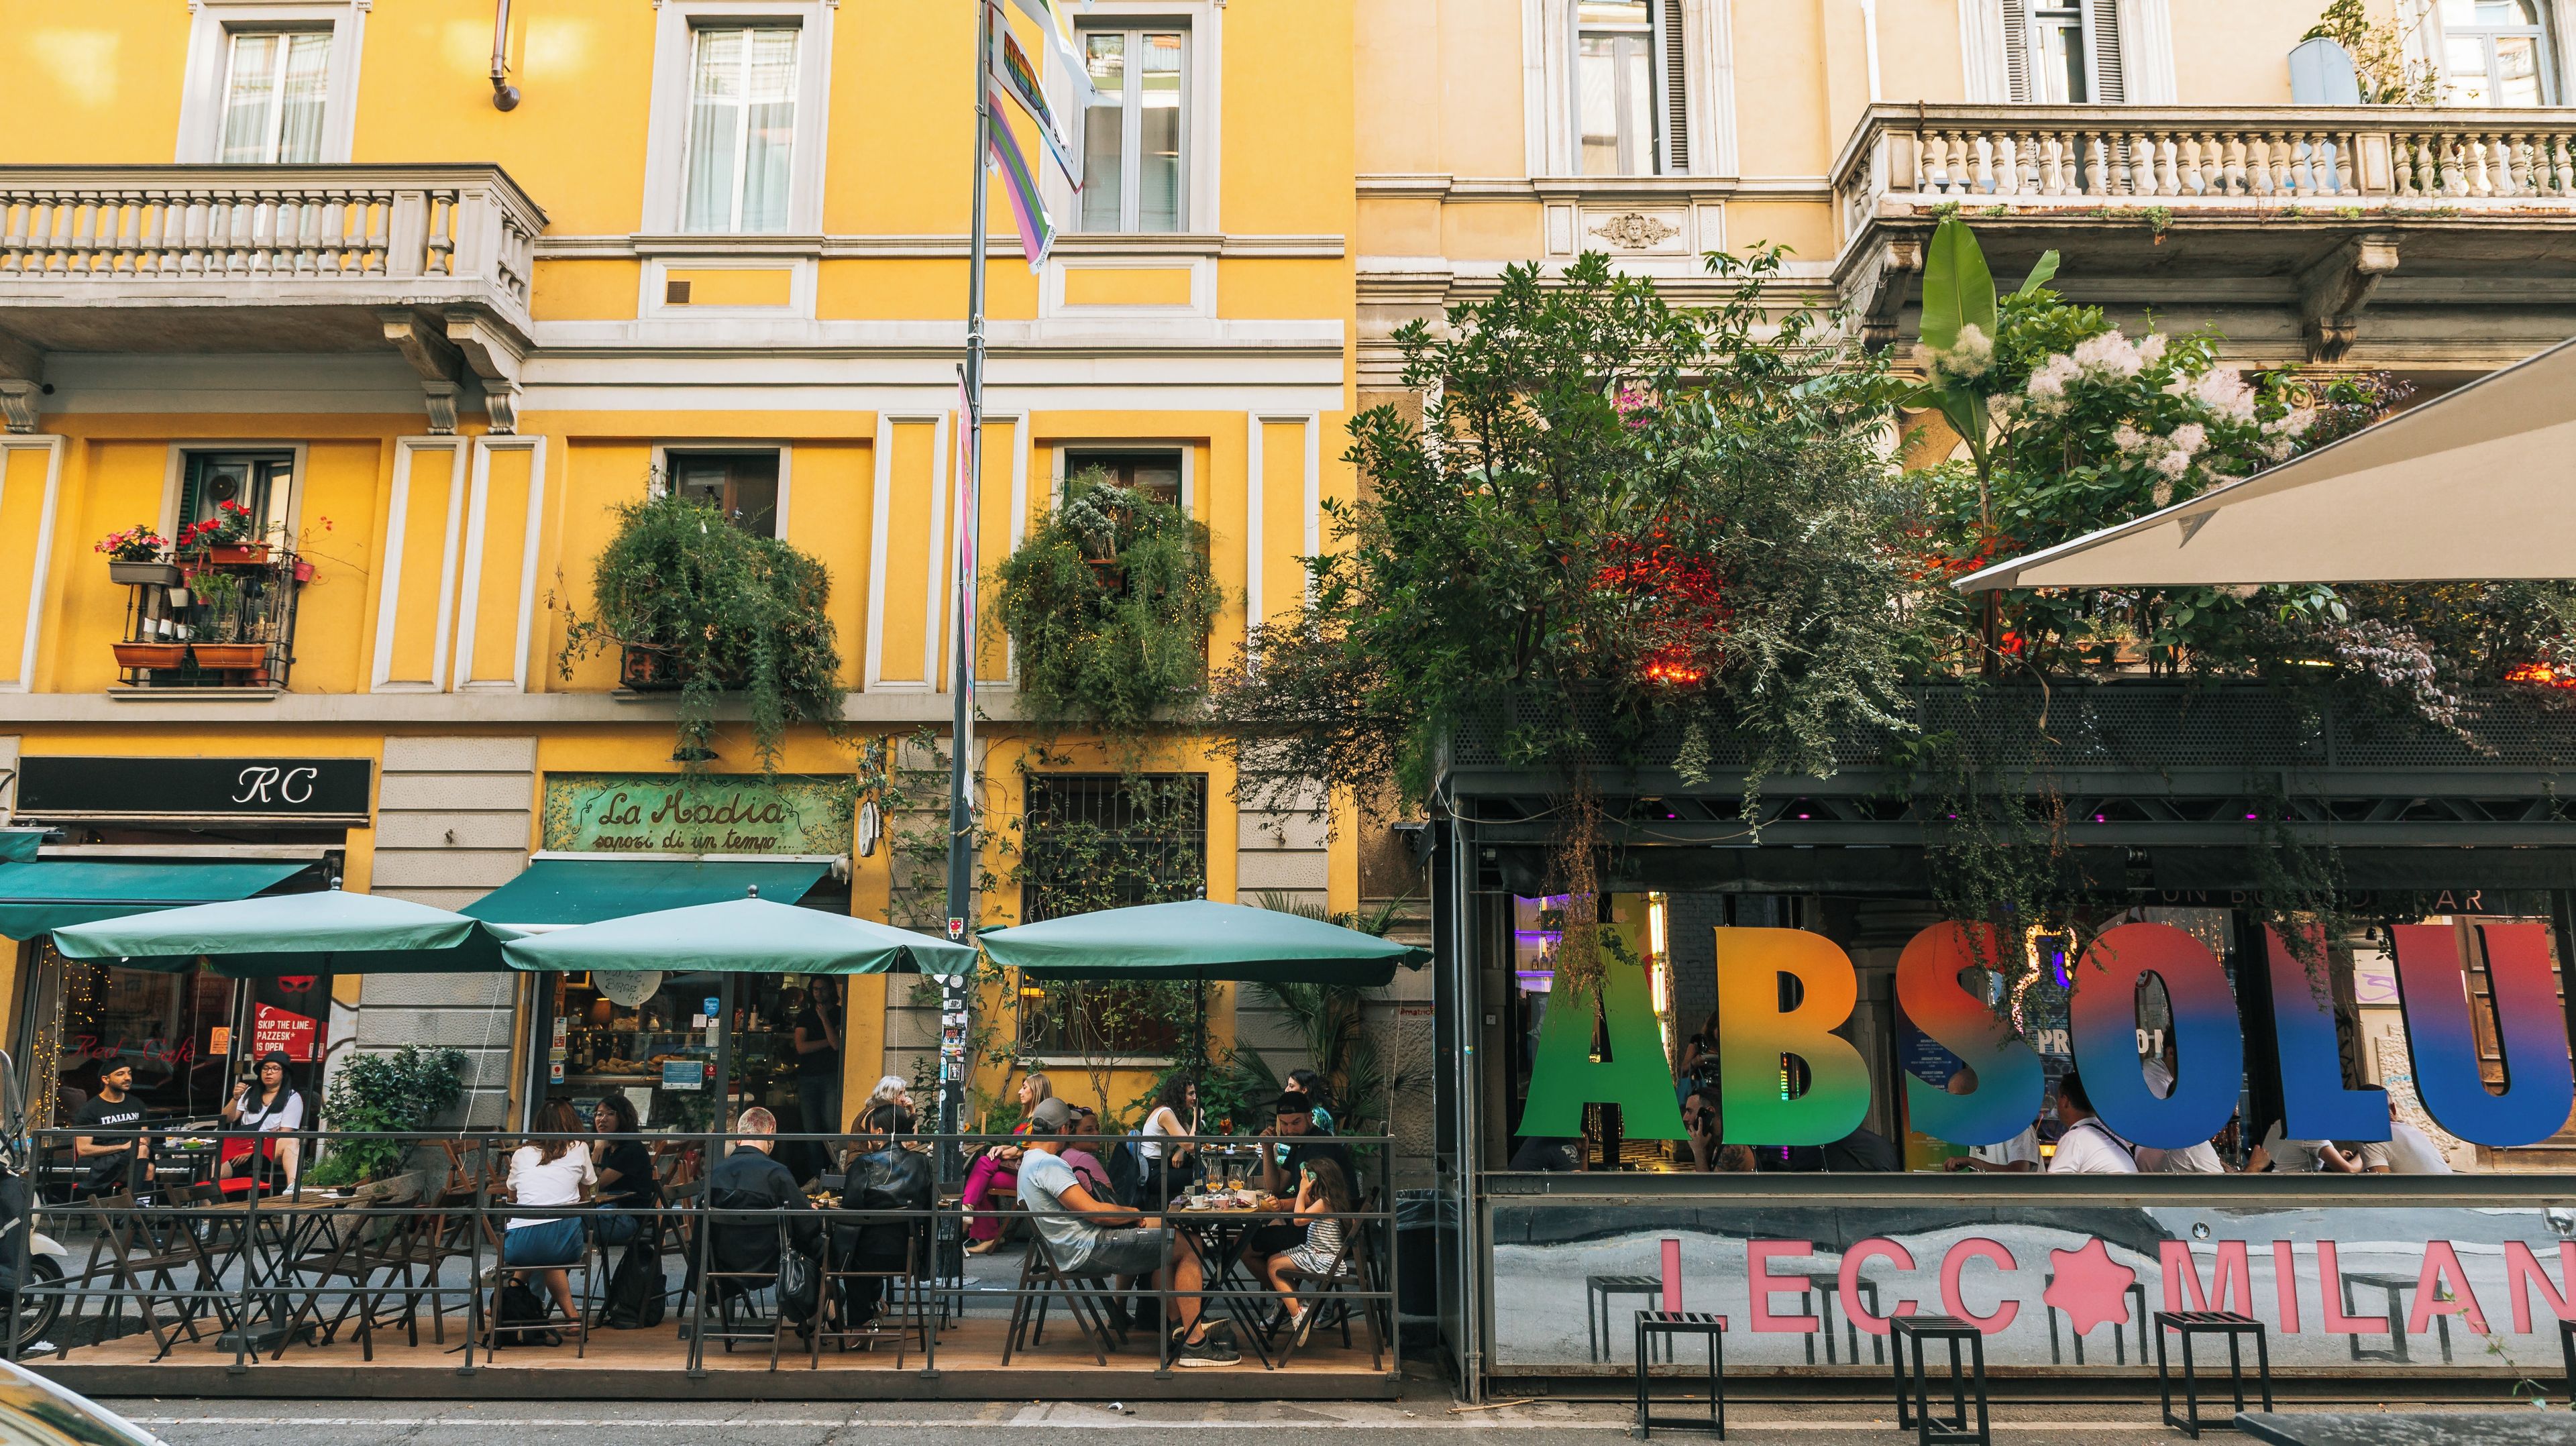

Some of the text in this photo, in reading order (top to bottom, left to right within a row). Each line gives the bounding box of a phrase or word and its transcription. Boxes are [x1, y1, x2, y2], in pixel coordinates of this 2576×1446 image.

[232, 767, 317, 803] RC
[598, 789, 786, 825] La Madia
[593, 830, 654, 852] sapori
[662, 829, 684, 848] di
[691, 836, 718, 849] un
[258, 1020, 275, 1030] SKIP
[277, 1020, 290, 1030] THE
[70, 1035, 126, 1059] Red
[256, 1042, 284, 1051] IS OPEN
